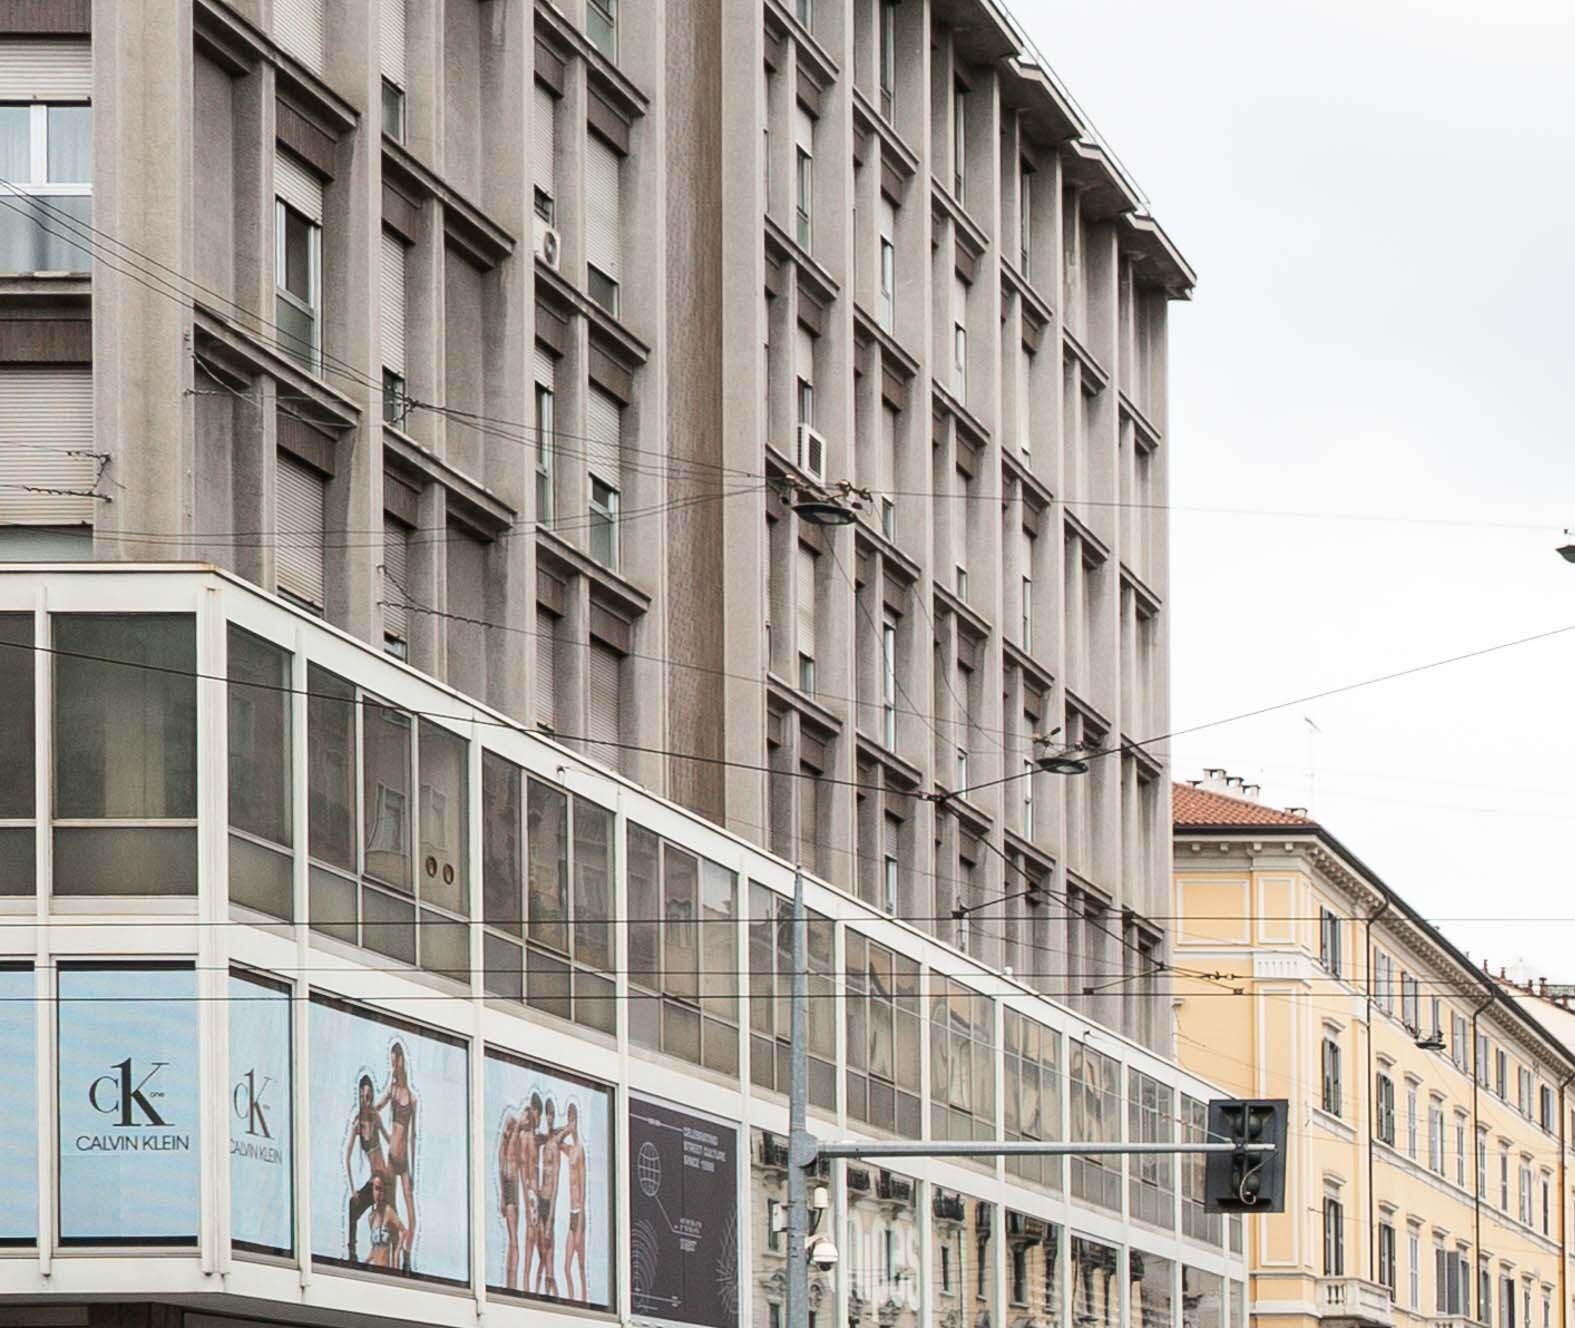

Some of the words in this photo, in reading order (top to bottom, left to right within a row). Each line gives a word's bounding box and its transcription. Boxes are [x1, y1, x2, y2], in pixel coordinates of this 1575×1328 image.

[76, 1135, 138, 1151] CALVIN
[143, 1135, 189, 1150] KLEIN
[259, 1144, 283, 1164] KLEIN
